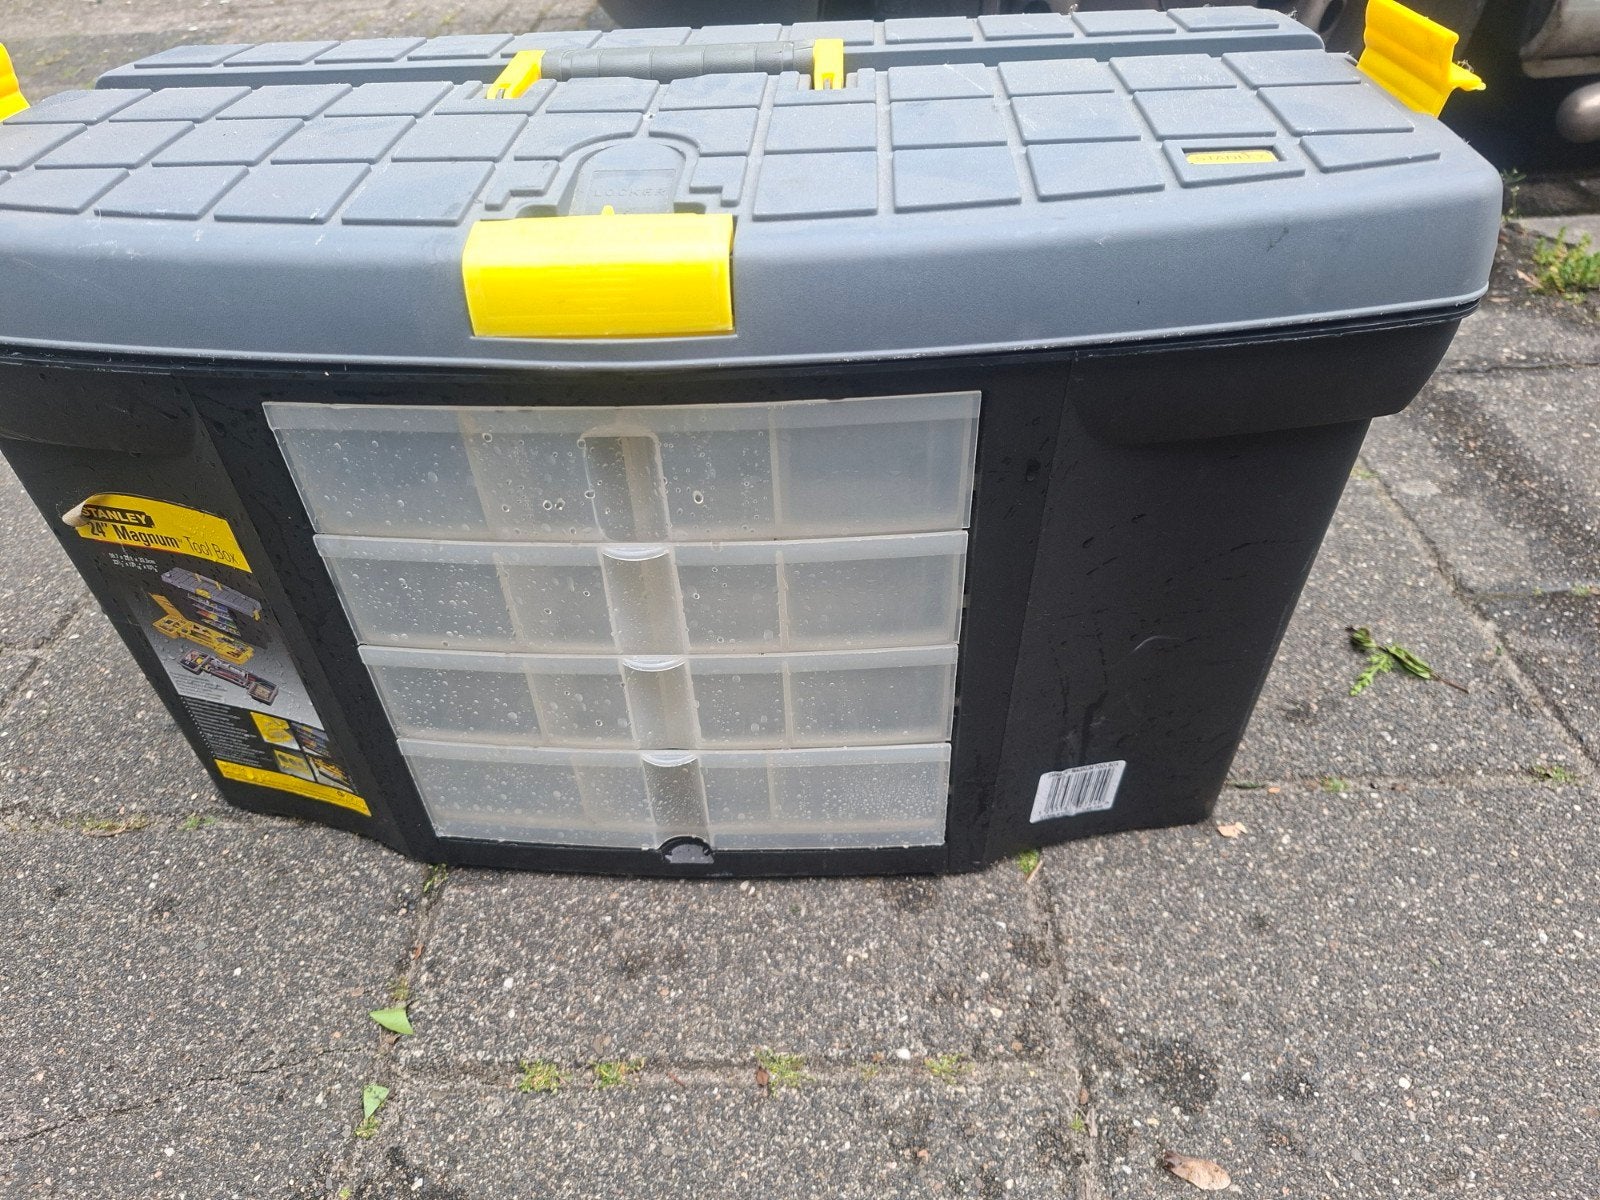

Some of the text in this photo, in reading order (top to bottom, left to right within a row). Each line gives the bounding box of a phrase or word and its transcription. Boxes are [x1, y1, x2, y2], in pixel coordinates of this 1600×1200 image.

[81, 507, 148, 525] STANLEY
[86, 521, 239, 564] 24" Magnum Tool Box
